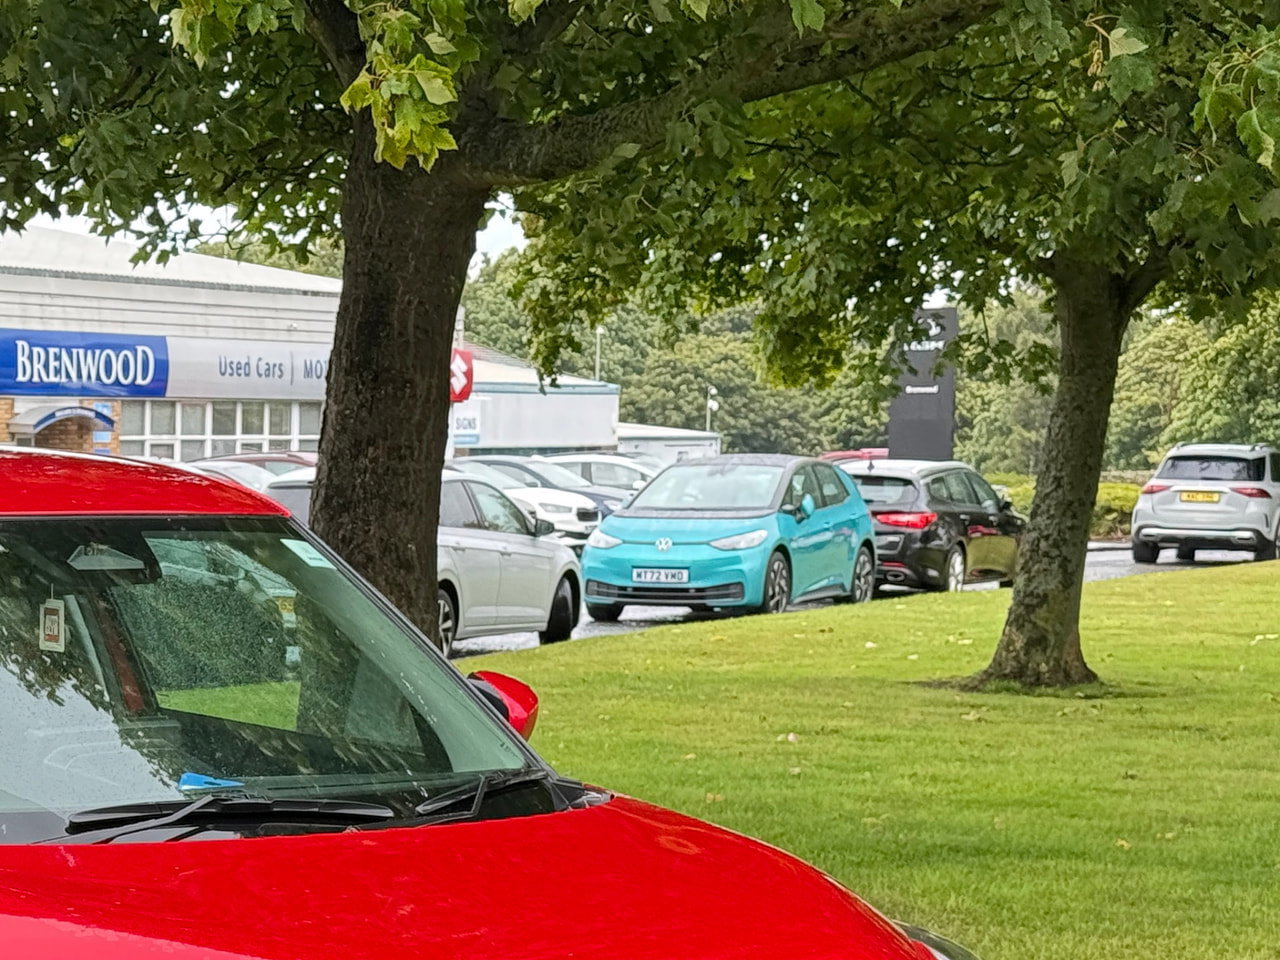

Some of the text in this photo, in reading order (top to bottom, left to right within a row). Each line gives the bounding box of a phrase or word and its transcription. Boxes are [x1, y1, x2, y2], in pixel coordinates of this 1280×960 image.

[15, 340, 155, 386] BRENWOOD
[218, 355, 251, 377] Used
[256, 357, 284, 379] Cars
